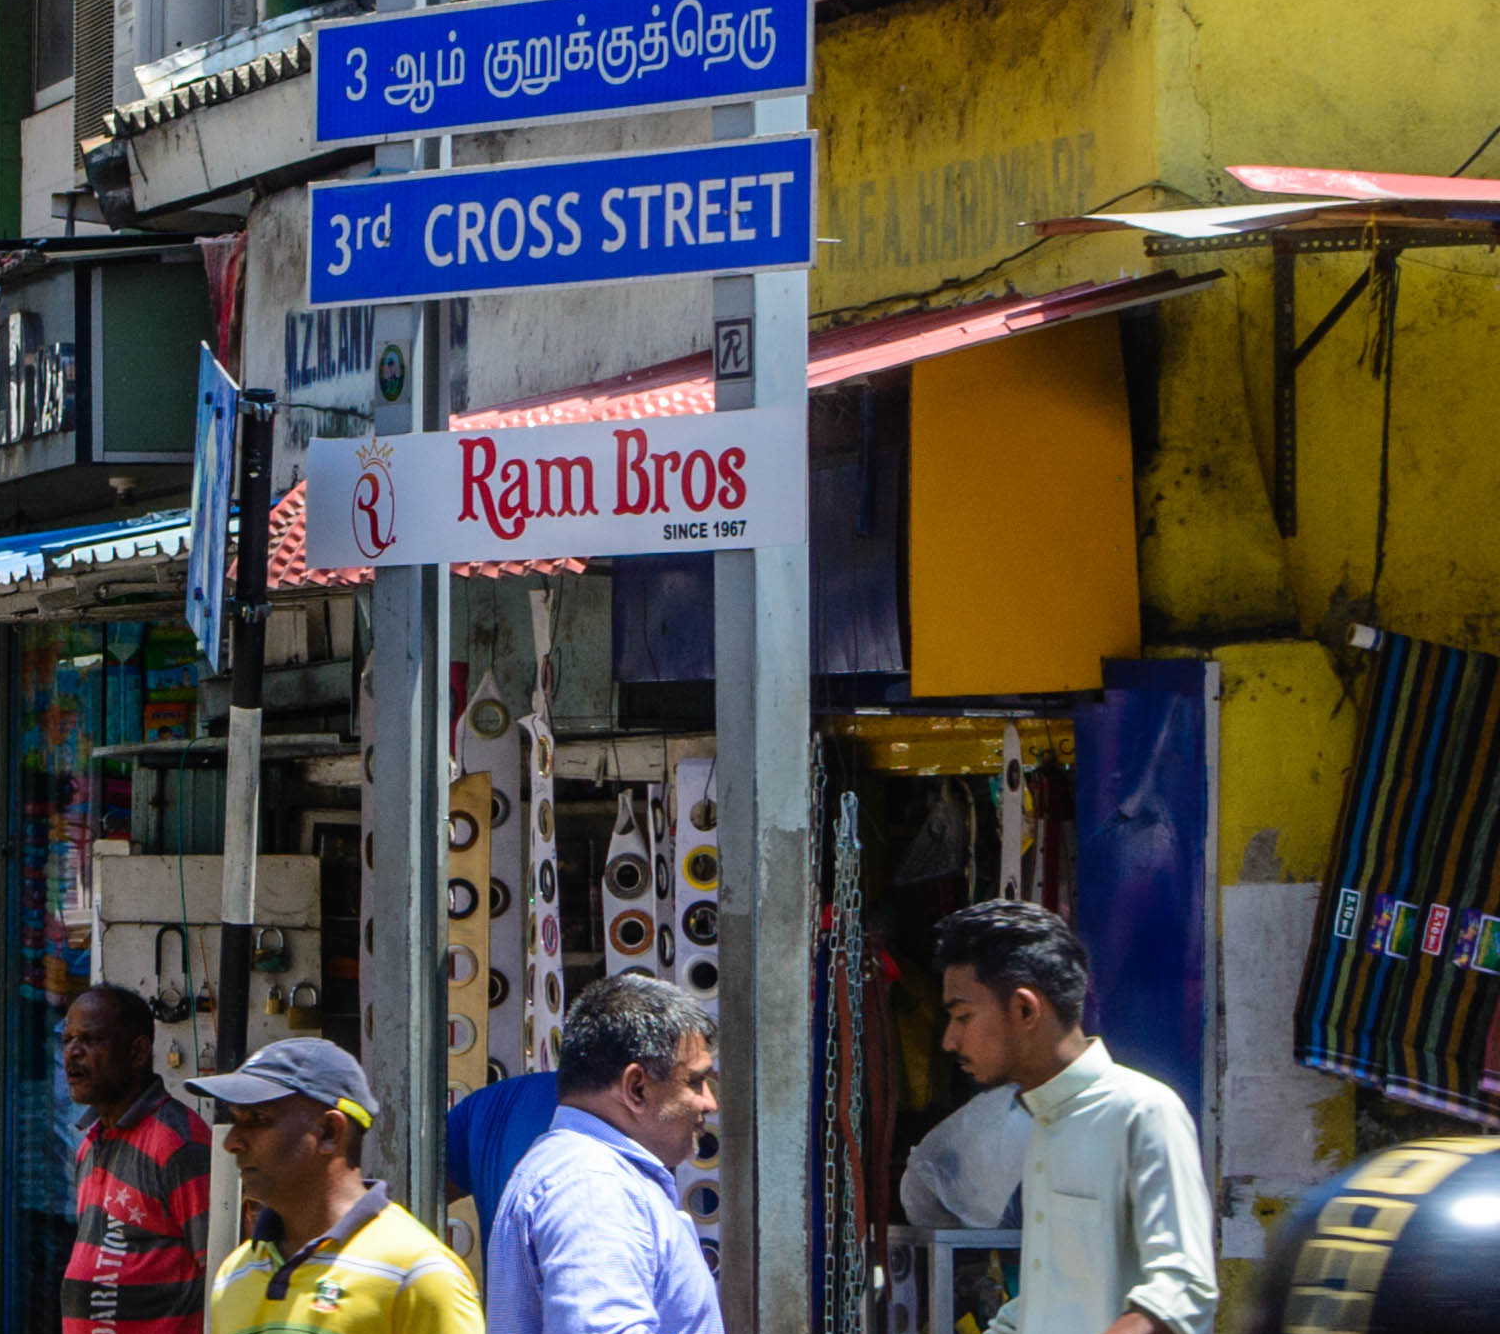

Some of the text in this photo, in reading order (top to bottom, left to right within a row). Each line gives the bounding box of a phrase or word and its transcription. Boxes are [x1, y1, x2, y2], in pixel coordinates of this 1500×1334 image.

[344, 45, 368, 102] 3
[383, 31, 465, 114] ஆம்
[327, 171, 794, 277] 3rd CROSS STREET
[456, 436, 599, 541] Ram
[612, 428, 747, 517] Bros
[662, 519, 747, 542] SINCE 1967
